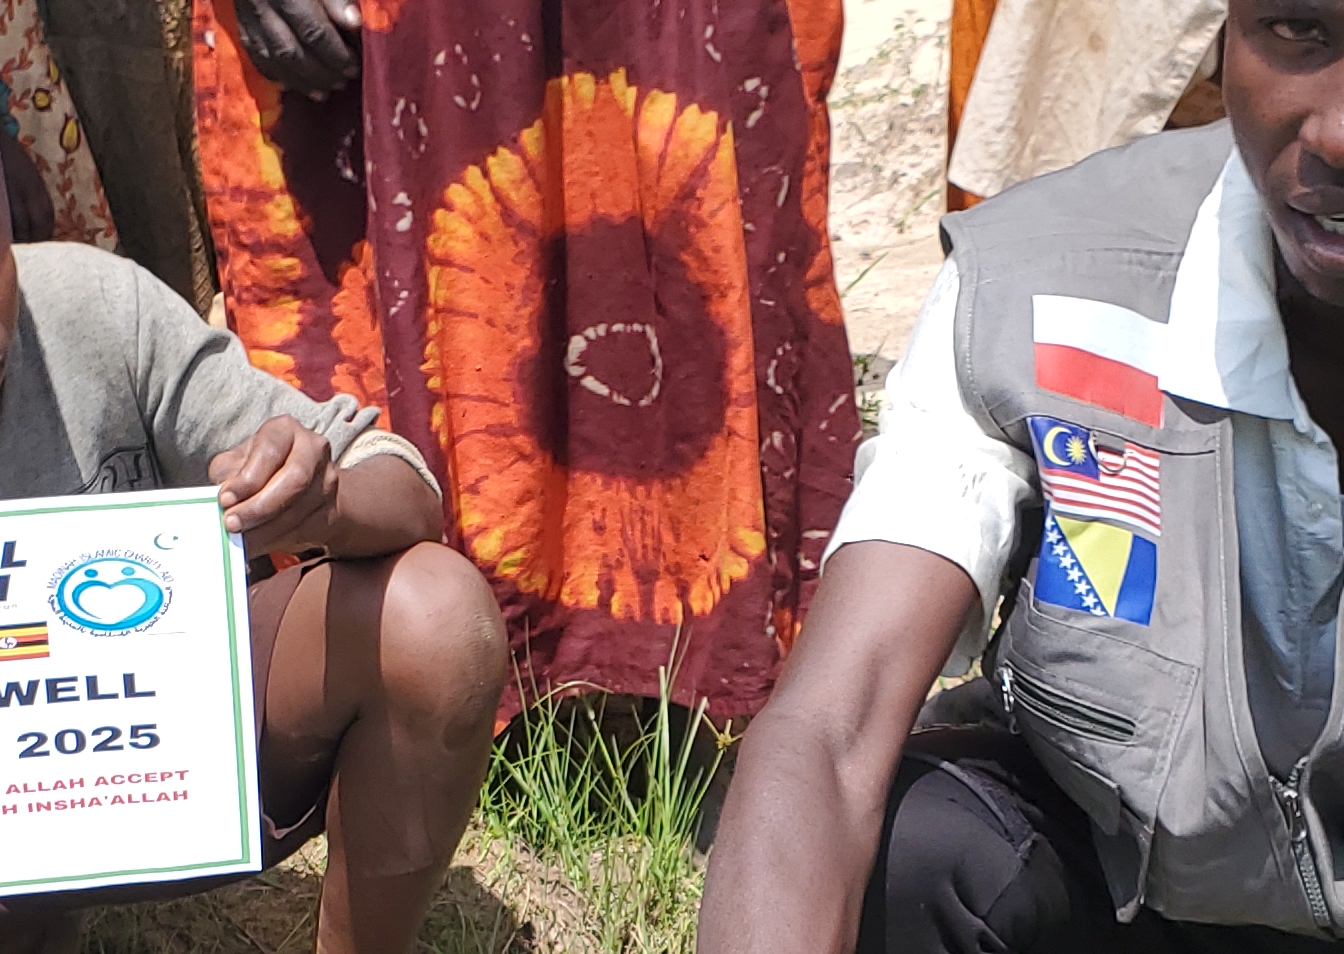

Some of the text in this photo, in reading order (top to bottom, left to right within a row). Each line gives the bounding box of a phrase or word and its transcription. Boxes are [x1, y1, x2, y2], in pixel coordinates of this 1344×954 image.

[78, 549, 122, 560] ISLAMIC
[160, 570, 175, 583] AID
[16, 723, 161, 760] 2025
[5, 778, 86, 797] ALLAH
[94, 769, 190, 788] ACCEPT
[27, 790, 190, 814] INSHA'ALLAH
